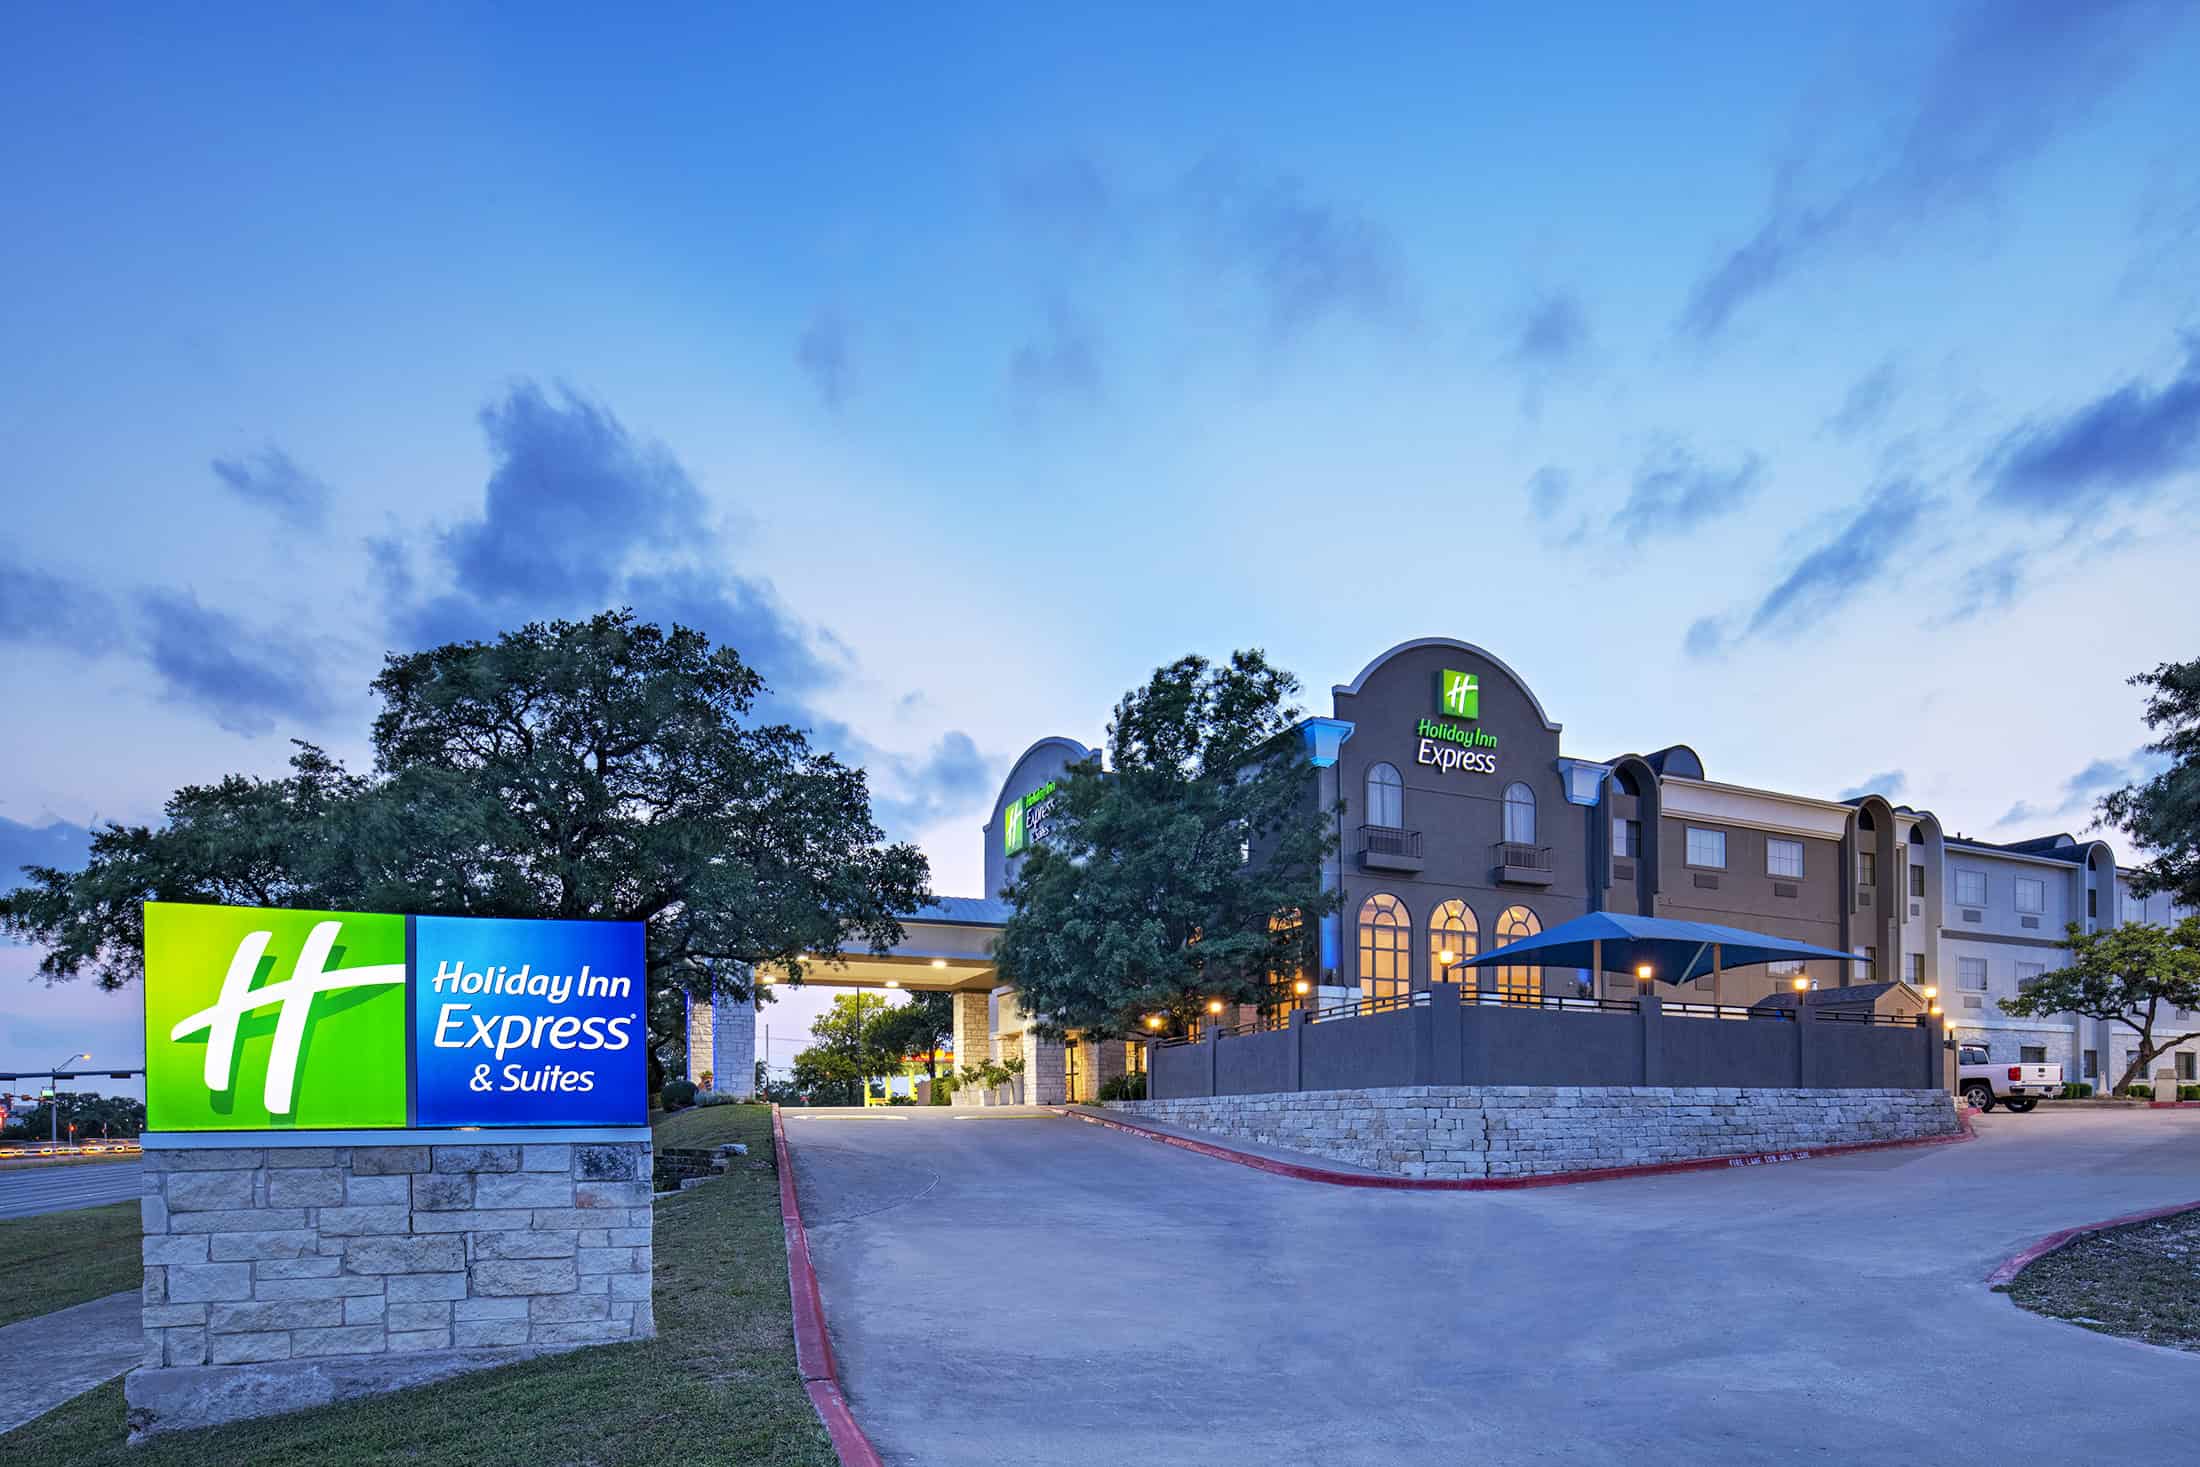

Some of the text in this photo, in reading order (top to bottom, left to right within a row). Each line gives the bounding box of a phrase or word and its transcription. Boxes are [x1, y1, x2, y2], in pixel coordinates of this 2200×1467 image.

[1417, 718, 1498, 748] Holiday Inn
[1418, 738, 1496, 774] Express
[432, 960, 631, 1004] Holiday Inn
[434, 1003, 632, 1060] Express
[469, 1063, 595, 1092] & Suites
